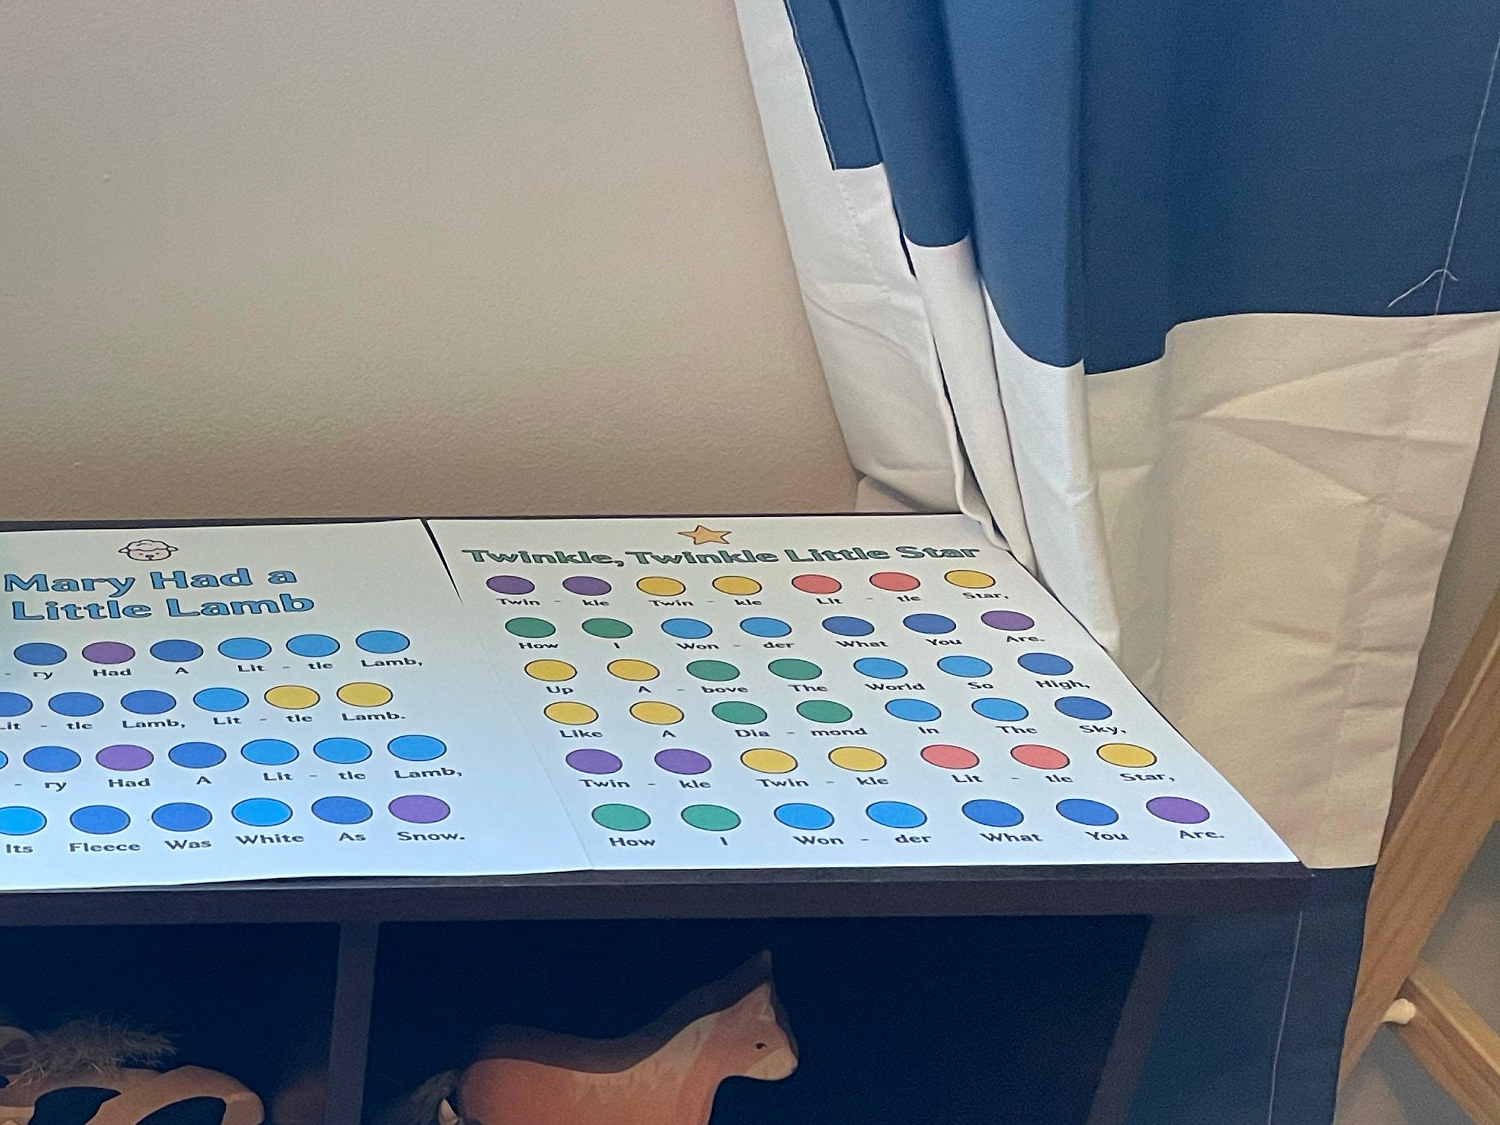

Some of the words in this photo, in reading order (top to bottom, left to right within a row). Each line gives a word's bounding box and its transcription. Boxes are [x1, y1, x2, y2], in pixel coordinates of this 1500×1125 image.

[461, 549, 625, 568] Twinkle,
[624, 549, 780, 565] Twinkle
[783, 547, 891, 563] Little
[897, 545, 981, 559] Star
[3, 573, 136, 599] Mary
[149, 567, 254, 590] Had
[267, 570, 298, 585] a
[11, 599, 153, 621] Little
[165, 593, 315, 618] Lamb
[496, 598, 541, 606] Twin
[581, 599, 610, 607] kle
[648, 599, 694, 607] Twin
[734, 598, 762, 606] kle
[816, 597, 842, 605] Lit
[896, 594, 921, 603] tle
[518, 642, 559, 650] How
[676, 642, 720, 650] Won
[763, 641, 795, 649] der
[835, 640, 889, 648] What
[924, 638, 963, 646] You
[32, 671, 54, 681] ry
[92, 668, 132, 677] Had
[174, 666, 189, 675] A
[237, 664, 265, 673] Lit
[307, 661, 333, 670] tle
[545, 685, 574, 695] Up
[638, 685, 652, 694] A
[700, 685, 749, 694] bove
[787, 684, 828, 692] The
[863, 682, 926, 691] World
[967, 681, 994, 690] So
[66, 721, 93, 730] tle
[213, 716, 242, 725] Lit
[285, 714, 313, 723] tle
[559, 729, 603, 738] Like
[662, 729, 677, 738] A
[734, 728, 771, 738] Dia
[810, 727, 868, 737] mond
[917, 726, 940, 735] In
[995, 725, 1038, 734] The
[44, 782, 67, 793] ry
[107, 777, 151, 788] Had
[196, 775, 212, 785] A
[263, 771, 293, 782] Lit
[337, 770, 366, 780] tle
[578, 778, 631, 788] Twin
[678, 779, 712, 789] kle
[755, 778, 810, 788] Twin
[855, 776, 889, 786] kle
[951, 774, 984, 783] Lit
[1045, 774, 1074, 783] tle
[5, 843, 34, 854] Its
[68, 842, 141, 853] Fleece
[164, 839, 212, 850] Was
[234, 833, 304, 845] White
[338, 832, 367, 842] As
[608, 837, 656, 847] How
[719, 836, 729, 846] I
[792, 835, 845, 845] Won
[894, 834, 932, 844] der
[979, 832, 1044, 843] What
[1084, 831, 1130, 841] You
